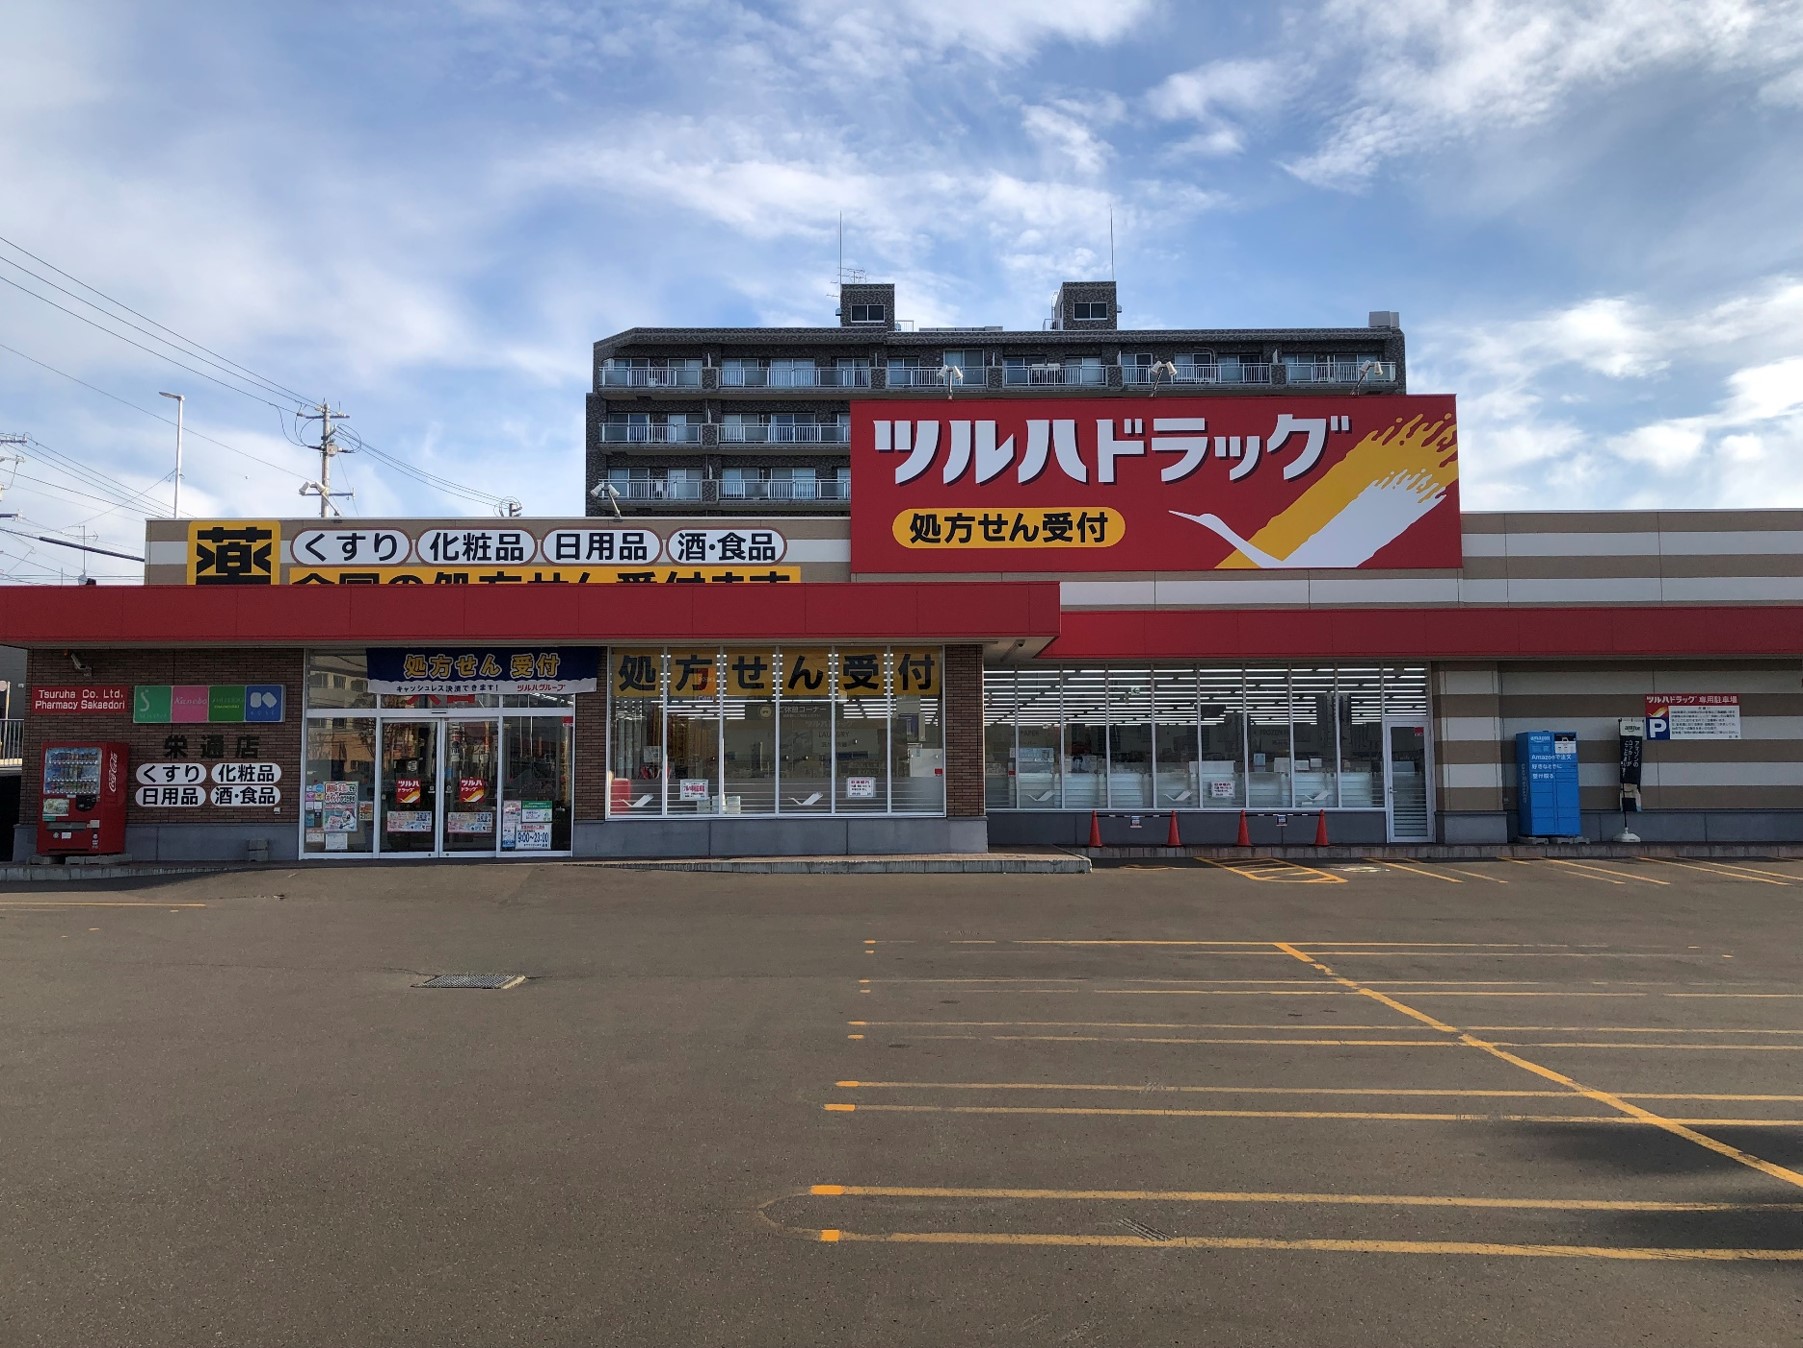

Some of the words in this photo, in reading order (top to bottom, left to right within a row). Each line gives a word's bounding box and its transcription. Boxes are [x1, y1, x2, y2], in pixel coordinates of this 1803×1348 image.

[873, 413, 1353, 486] ツルハドラッグ
[909, 511, 1109, 545] 処方せん受付
[304, 532, 397, 562] くすり
[430, 531, 524, 562] 化粧品
[556, 532, 648, 561] 日用品
[618, 653, 935, 692] 処方せん受付
[38, 689, 76, 699] Tsuruha
[82, 689, 99, 699] Co.
[103, 689, 123, 699] Ltd.
[516, 683, 566, 692] ツルハグループ
[35, 700, 78, 711] Pharmacy
[81, 700, 125, 710] Sakaedori
[1646, 695, 1697, 704] ツルハドラッグ
[1649, 718, 1667, 738] P
[164, 734, 260, 759] 栄通店
[143, 765, 200, 783] くすり
[218, 764, 275, 783] 化粧品
[461, 779, 483, 787] ツルハ
[398, 780, 420, 788] ツルハ
[142, 787, 199, 805] 日用品
